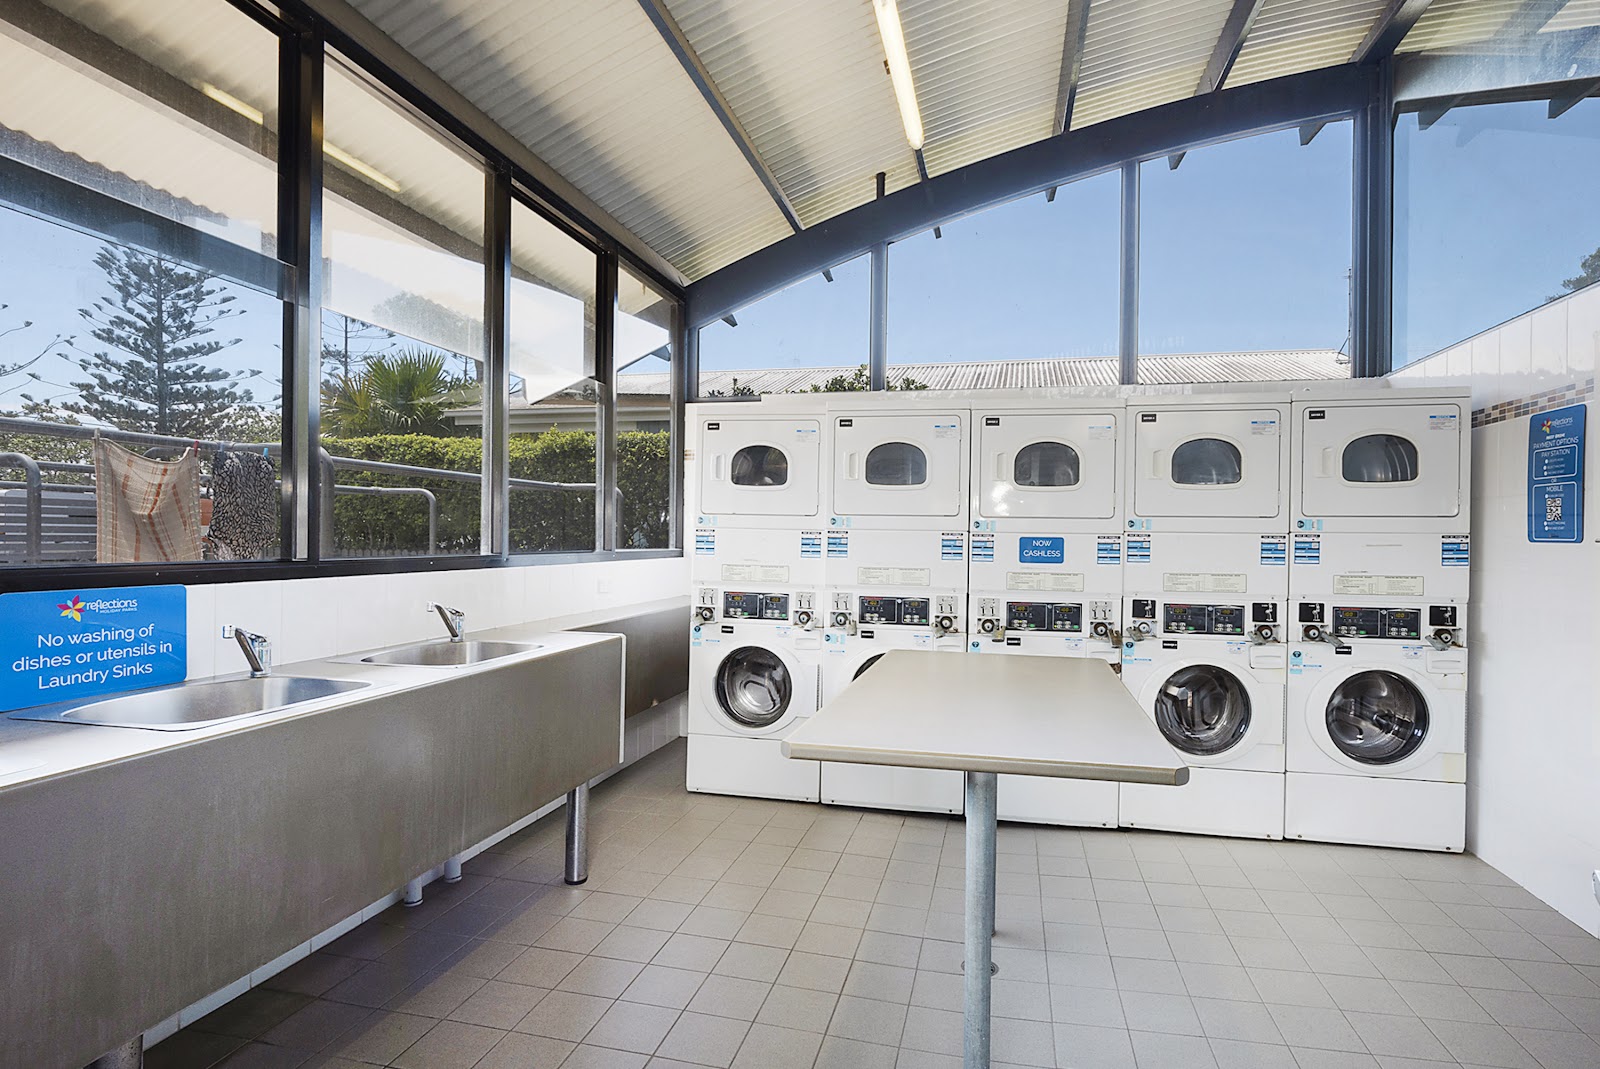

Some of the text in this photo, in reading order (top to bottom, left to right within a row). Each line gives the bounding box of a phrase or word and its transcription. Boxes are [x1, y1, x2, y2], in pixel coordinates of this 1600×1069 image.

[1533, 440, 1556, 449] PAYMENT
[1556, 436, 1579, 446] OPTIONS
[1550, 448, 1571, 457] STATION
[1023, 549, 1061, 557] CASHLESS
[86, 598, 138, 613] reflections
[38, 623, 155, 648] No washing of
[12, 641, 173, 672] dishes or utensils in
[38, 662, 153, 690] Laundry Sinks
